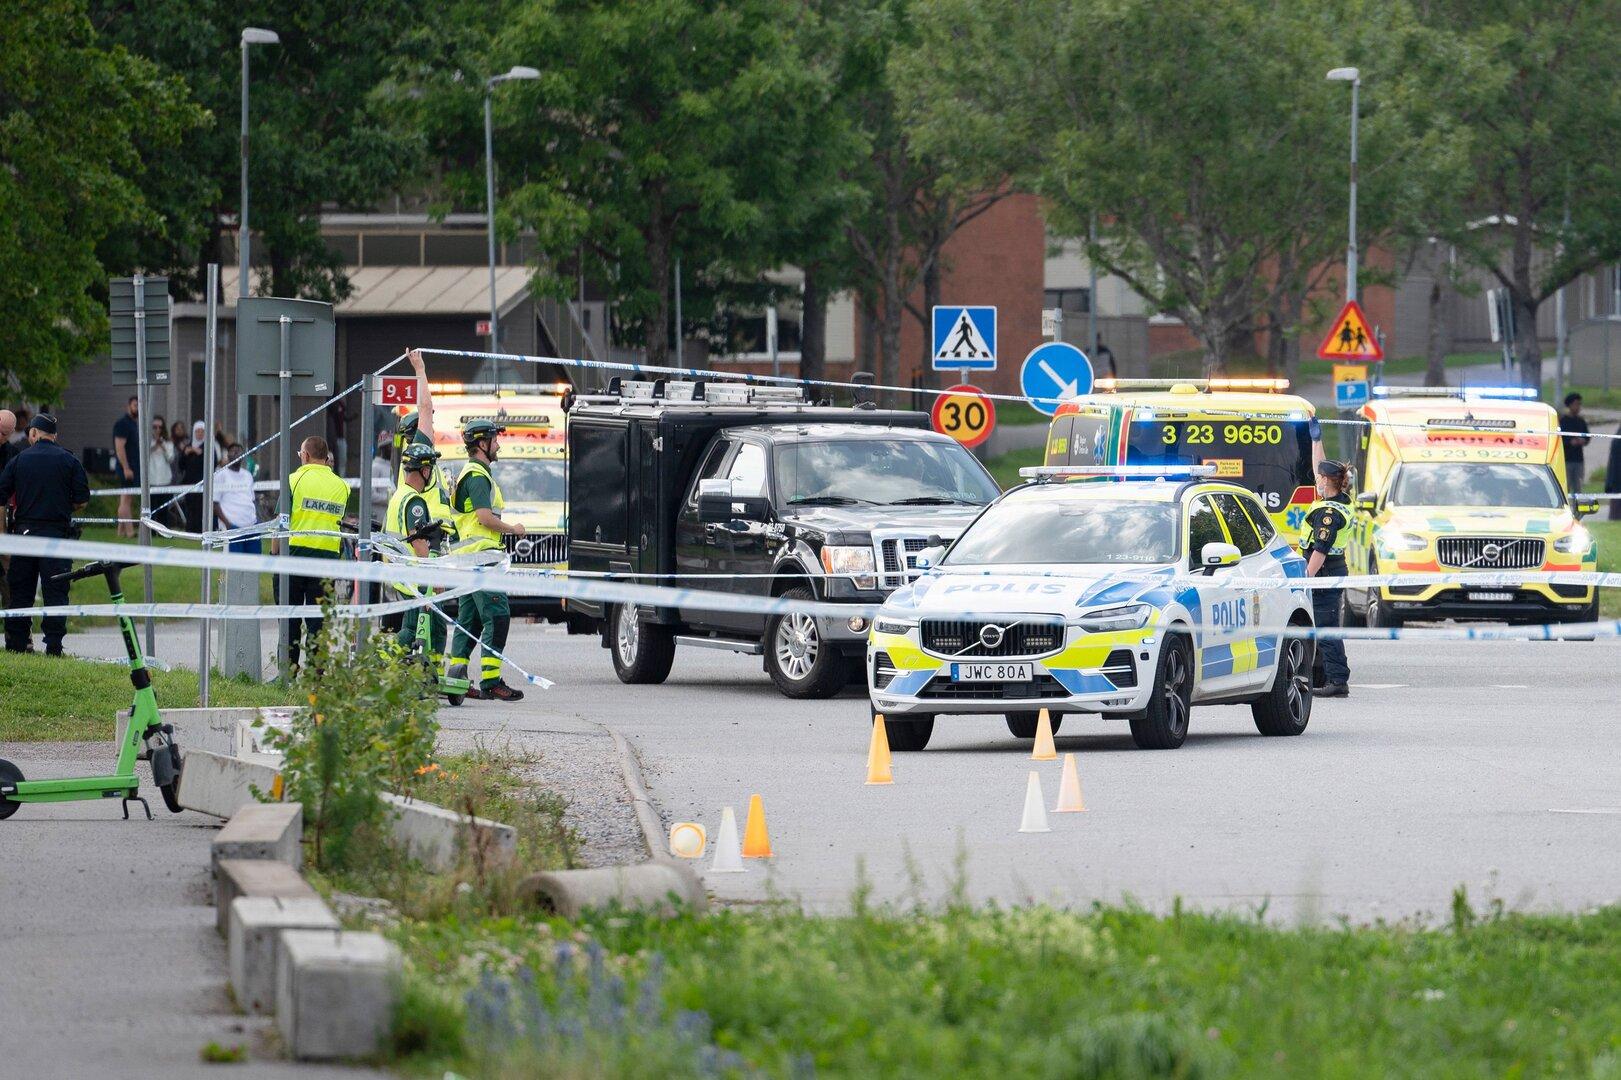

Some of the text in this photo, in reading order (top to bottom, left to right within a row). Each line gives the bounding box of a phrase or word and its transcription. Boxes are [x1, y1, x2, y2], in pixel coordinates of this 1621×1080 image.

[944, 401, 985, 431] 30
[1162, 424, 1282, 444] 3 23 9650
[1443, 449, 1467, 458] 23
[1477, 449, 1528, 460] 9220
[305, 500, 341, 514] LÄKARE
[943, 583, 1067, 595] POLIS
[1212, 598, 1246, 627] POLIS
[965, 665, 1026, 679] JWC 80A
